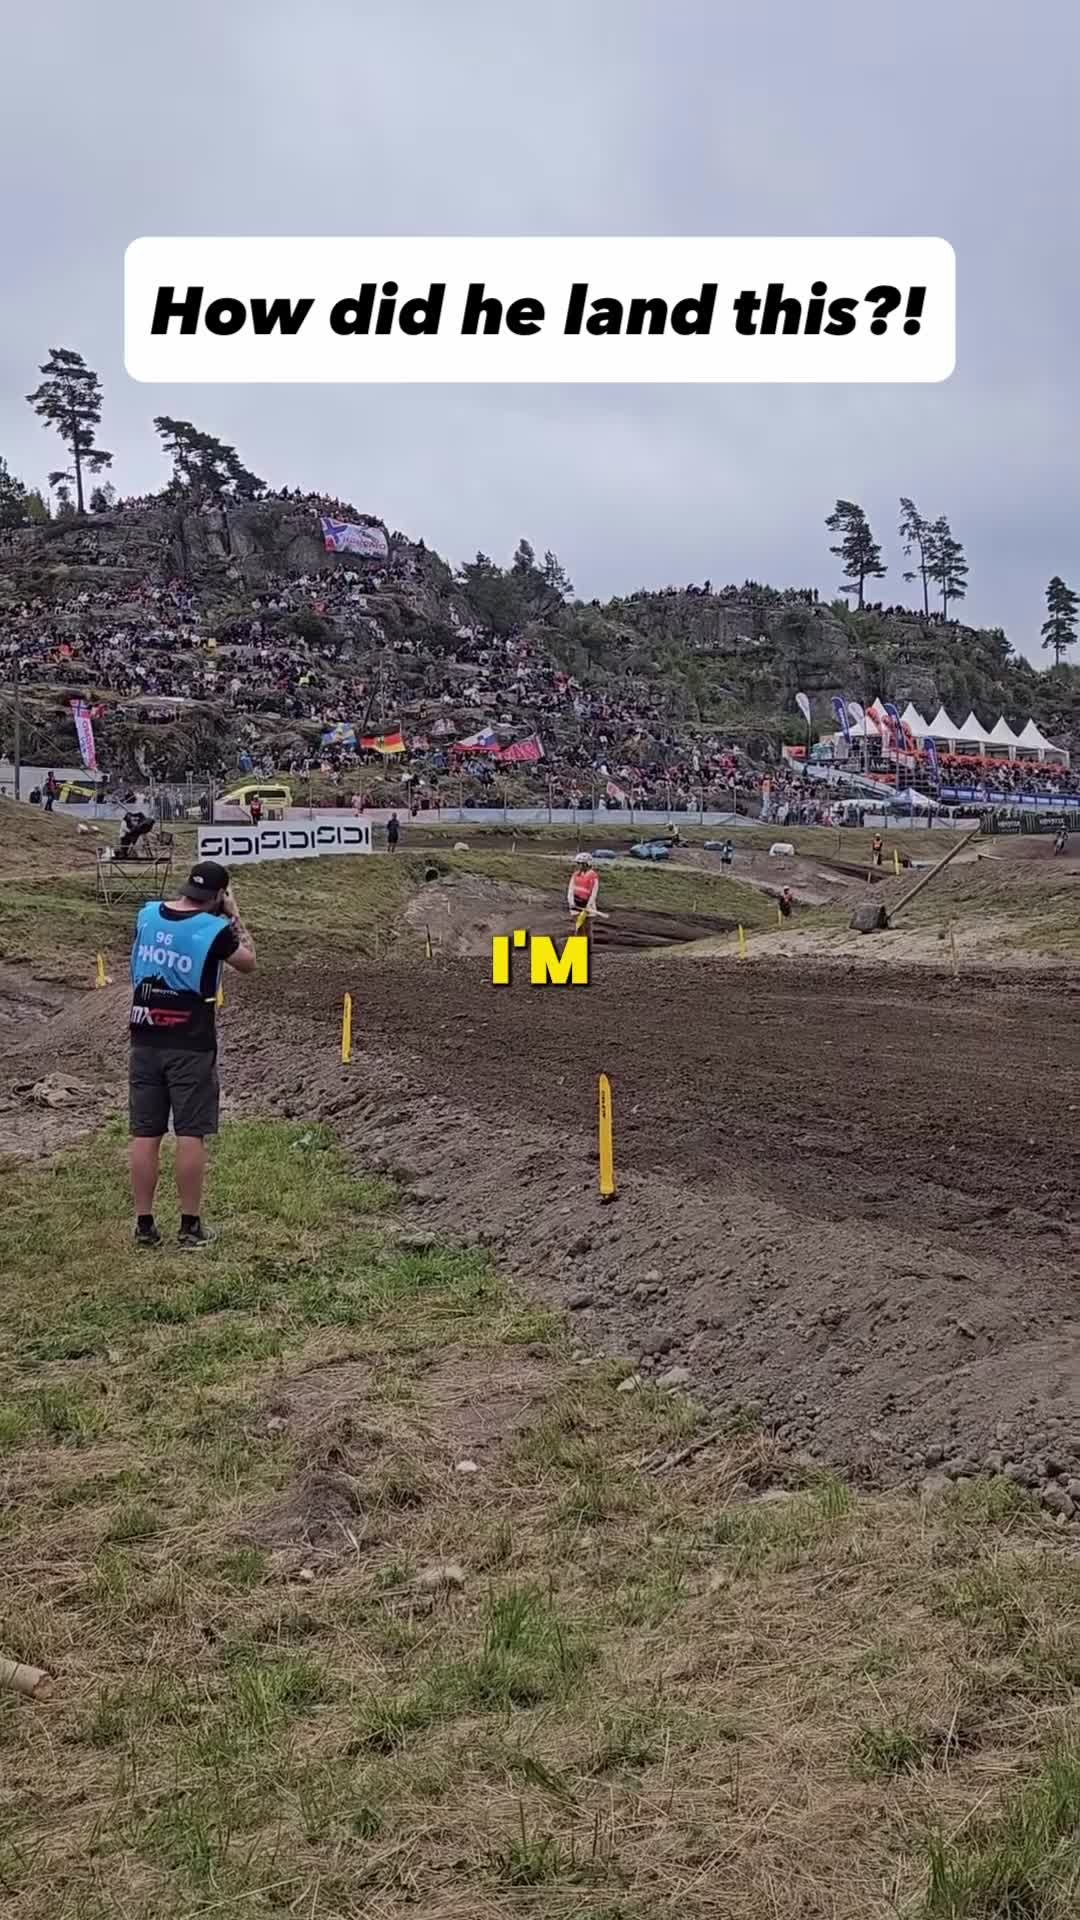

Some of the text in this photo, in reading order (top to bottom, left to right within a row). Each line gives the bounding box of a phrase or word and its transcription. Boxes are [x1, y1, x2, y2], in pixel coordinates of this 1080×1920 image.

[200, 825, 369, 857] SIDI SIDI SIDI
[155, 931, 174, 945] 96
[137, 945, 193, 973] PHOTO
